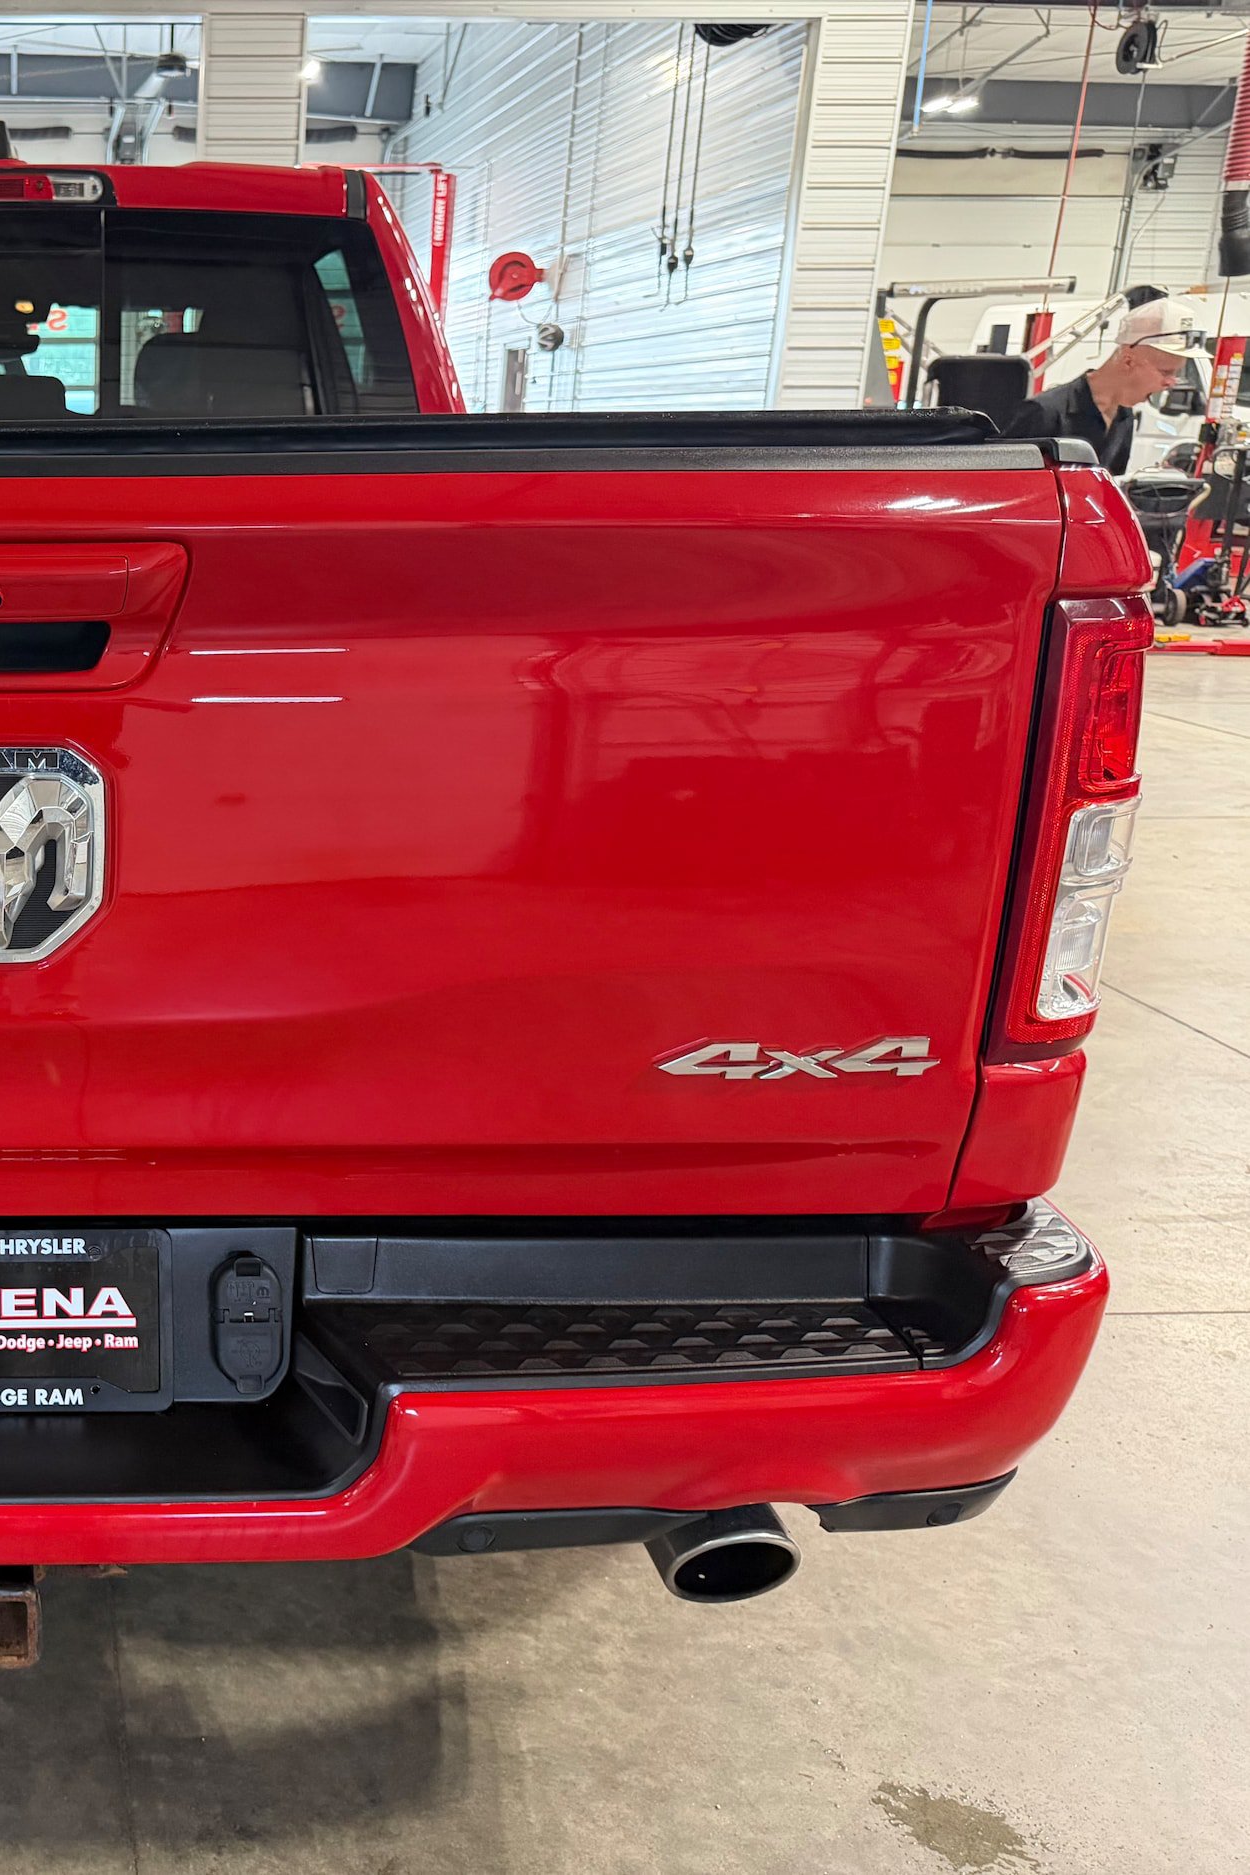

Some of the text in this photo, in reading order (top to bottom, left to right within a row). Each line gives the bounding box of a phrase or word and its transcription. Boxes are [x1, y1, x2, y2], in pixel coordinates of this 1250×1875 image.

[55, 1334, 92, 1352] Jeep
[104, 1333, 139, 1349] Ram
[35, 1388, 84, 1406] RAM
